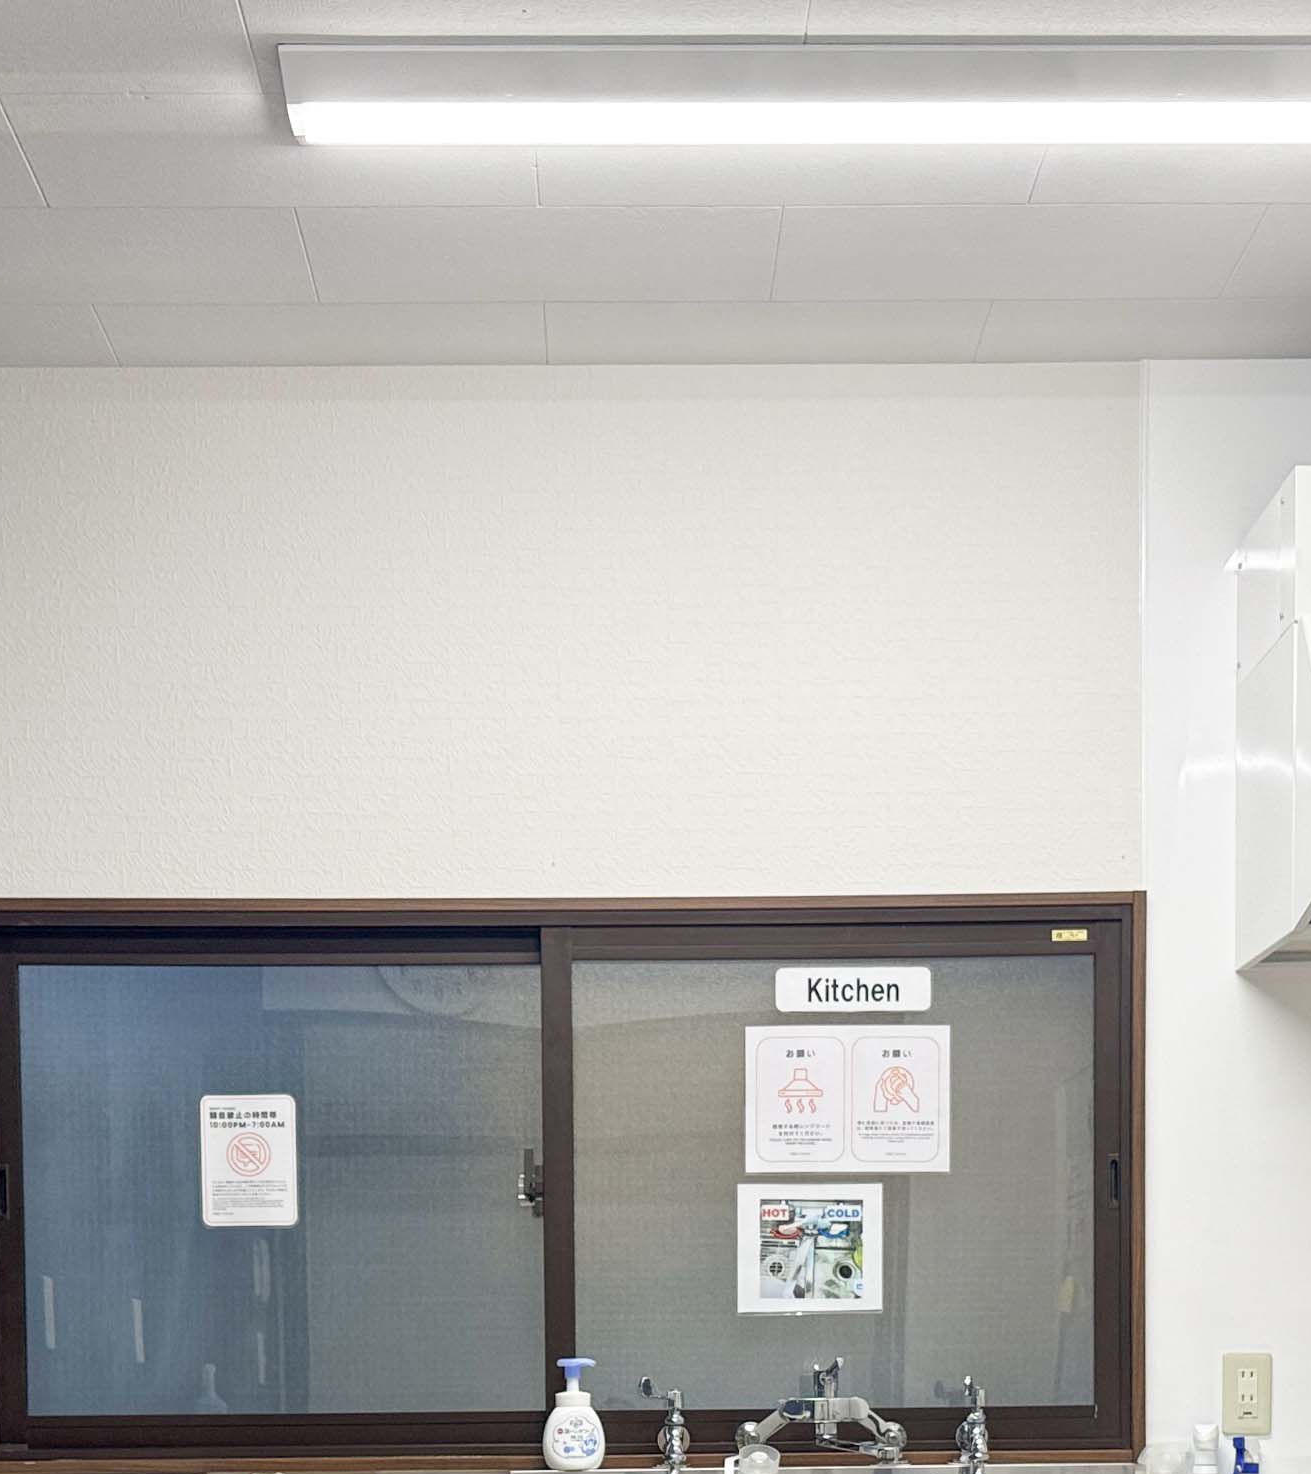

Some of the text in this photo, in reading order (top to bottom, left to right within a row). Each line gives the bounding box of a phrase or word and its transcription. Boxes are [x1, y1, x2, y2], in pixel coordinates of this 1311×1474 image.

[807, 977, 900, 1002] Kitchen
[785, 1049, 816, 1058] お願い
[881, 1049, 912, 1058] お願い
[762, 1208, 787, 1218] HOT
[827, 1209, 860, 1218] COLD
